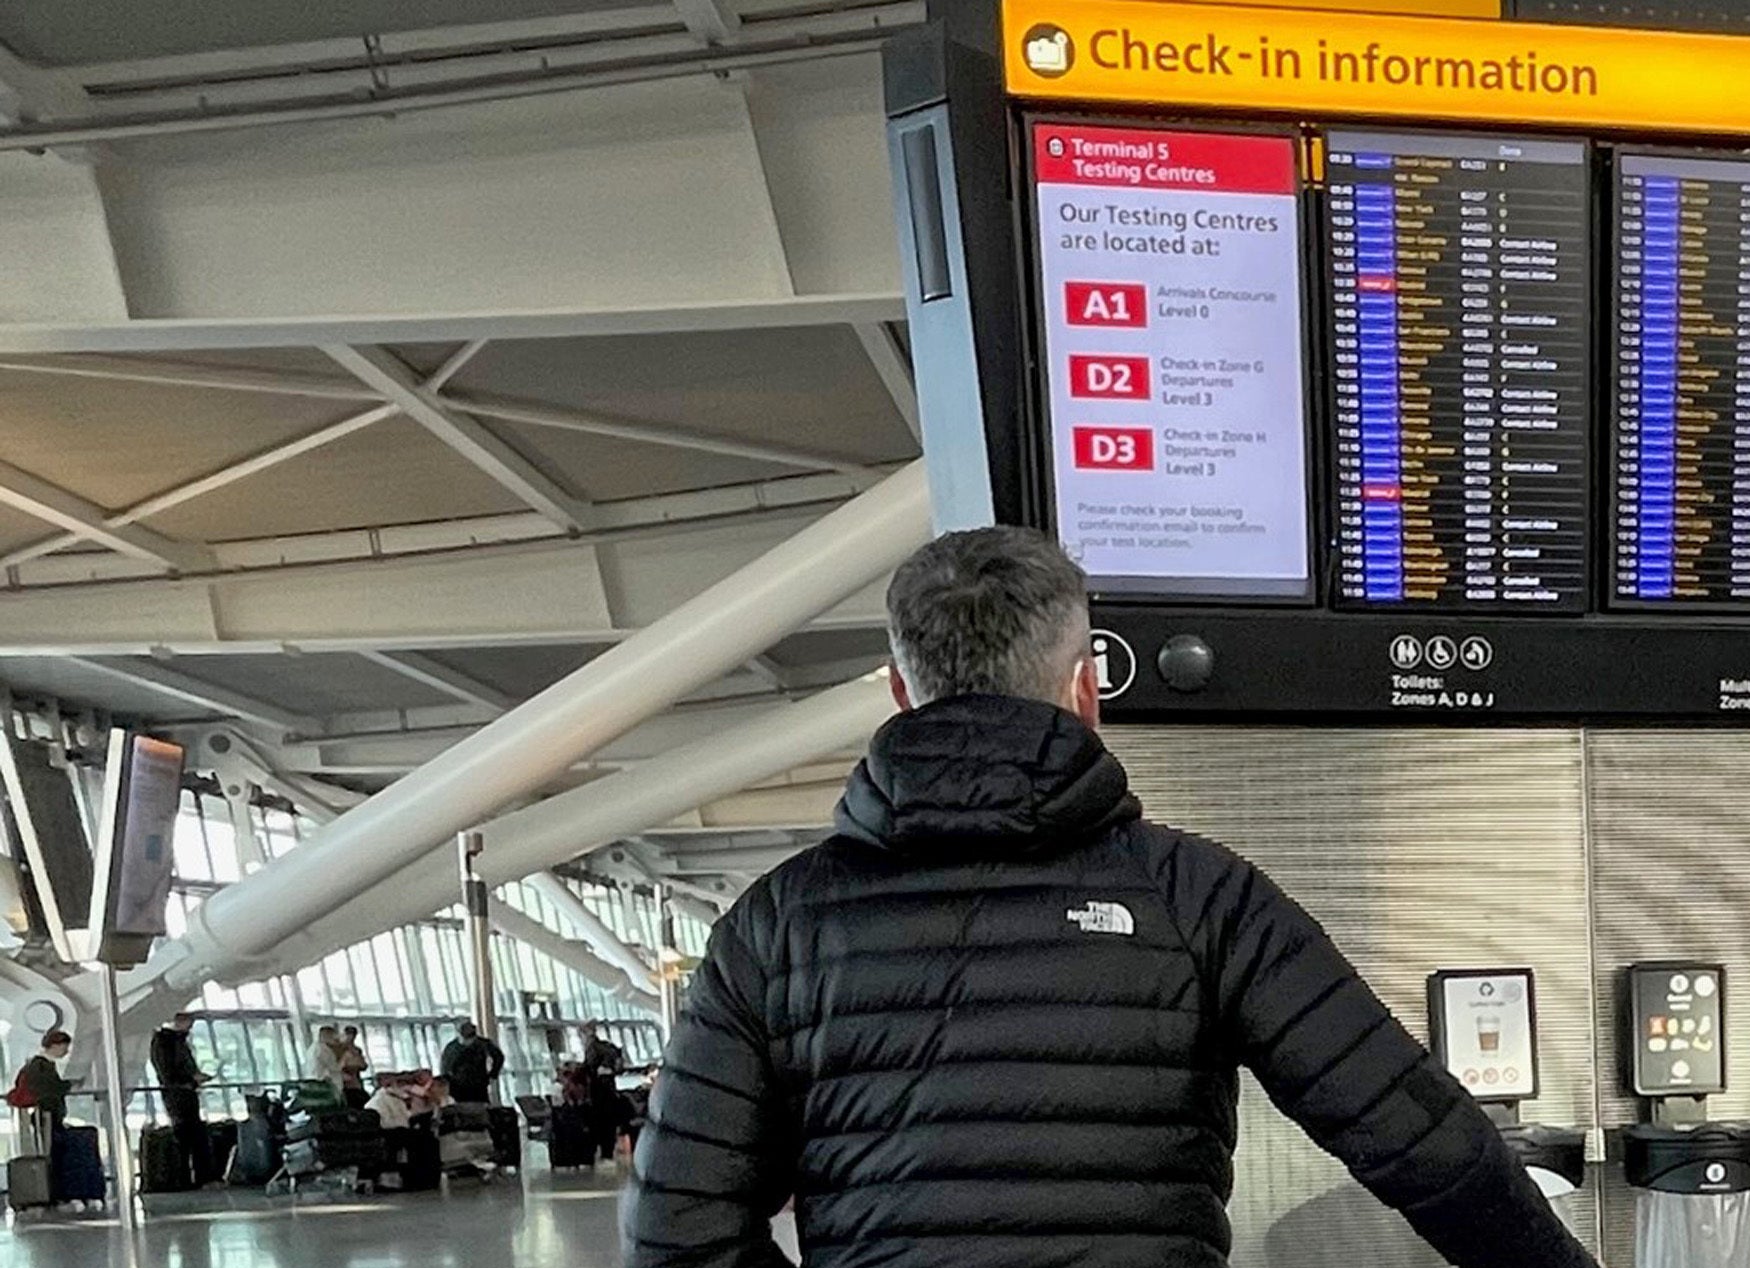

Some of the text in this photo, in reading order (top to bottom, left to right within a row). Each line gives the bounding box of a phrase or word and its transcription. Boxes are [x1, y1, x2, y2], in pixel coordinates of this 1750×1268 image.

[1090, 29, 1597, 96] Check-in information
[1071, 138, 1169, 160] Terminal 5
[1073, 159, 1216, 184] Testing Centres
[1060, 203, 1279, 232] Our Testing Centres
[1060, 232, 1221, 256] are located at:
[1157, 286, 1277, 302] Arrivals Concourse
[1083, 290, 1130, 320] A1
[1158, 304, 1197, 317] Level
[1161, 357, 1216, 371] Check-in
[1218, 359, 1251, 372] Zone
[1087, 363, 1133, 392] D2
[1162, 374, 1234, 389] Departures
[1163, 392, 1213, 405] Level 3
[1163, 428, 1218, 442] Check-in
[1221, 430, 1254, 443] Zone
[1091, 434, 1136, 463] D3
[1165, 445, 1236, 459] Departures
[1166, 463, 1216, 476] Level 3
[1077, 503, 1243, 522] Please check your booking
[1077, 519, 1266, 534] confirmation email to confirm
[1392, 675, 1444, 689] Toilets:
[1392, 691, 1436, 706] Zones
[1456, 692, 1468, 706] D
[1486, 692, 1494, 707] J
